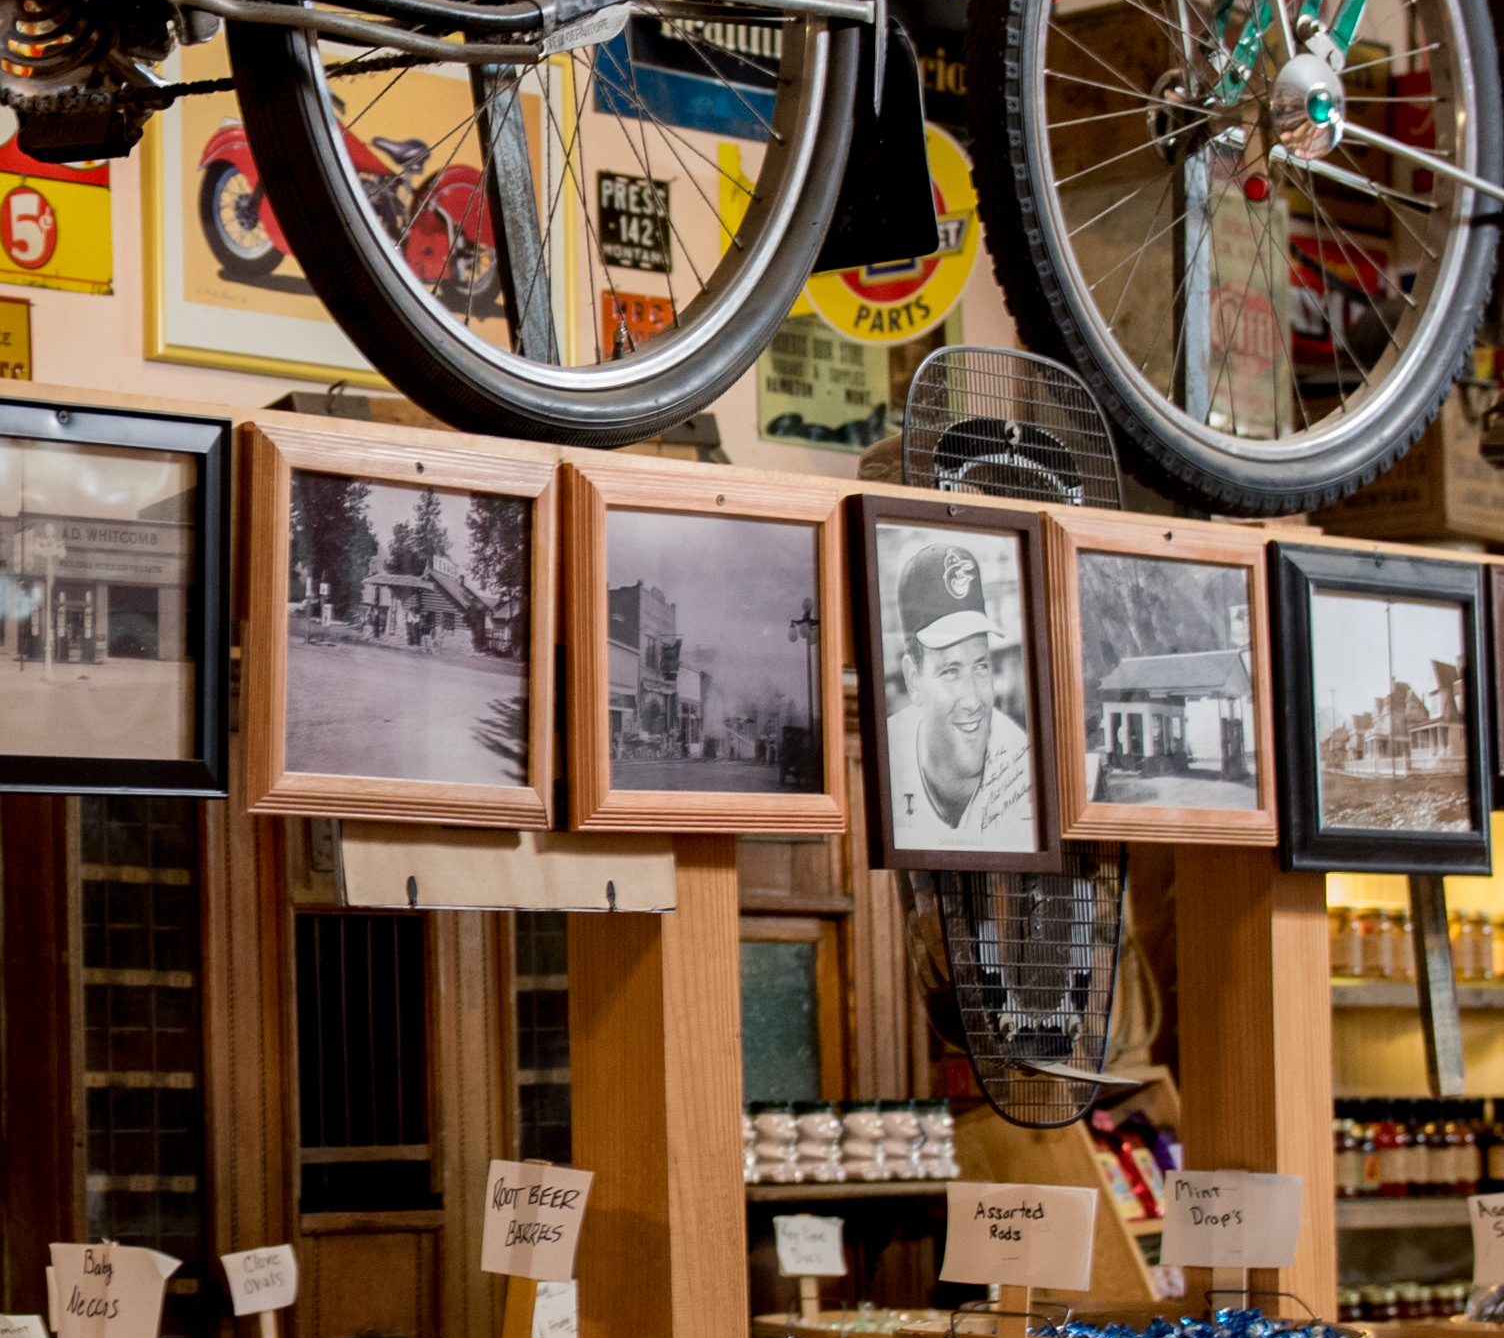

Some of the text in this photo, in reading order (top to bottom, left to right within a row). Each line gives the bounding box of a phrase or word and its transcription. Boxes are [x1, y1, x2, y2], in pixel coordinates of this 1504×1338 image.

[601, 179, 668, 217] PRESS
[854, 295, 930, 334] PARTS
[528, 1186, 578, 1210] BEER
